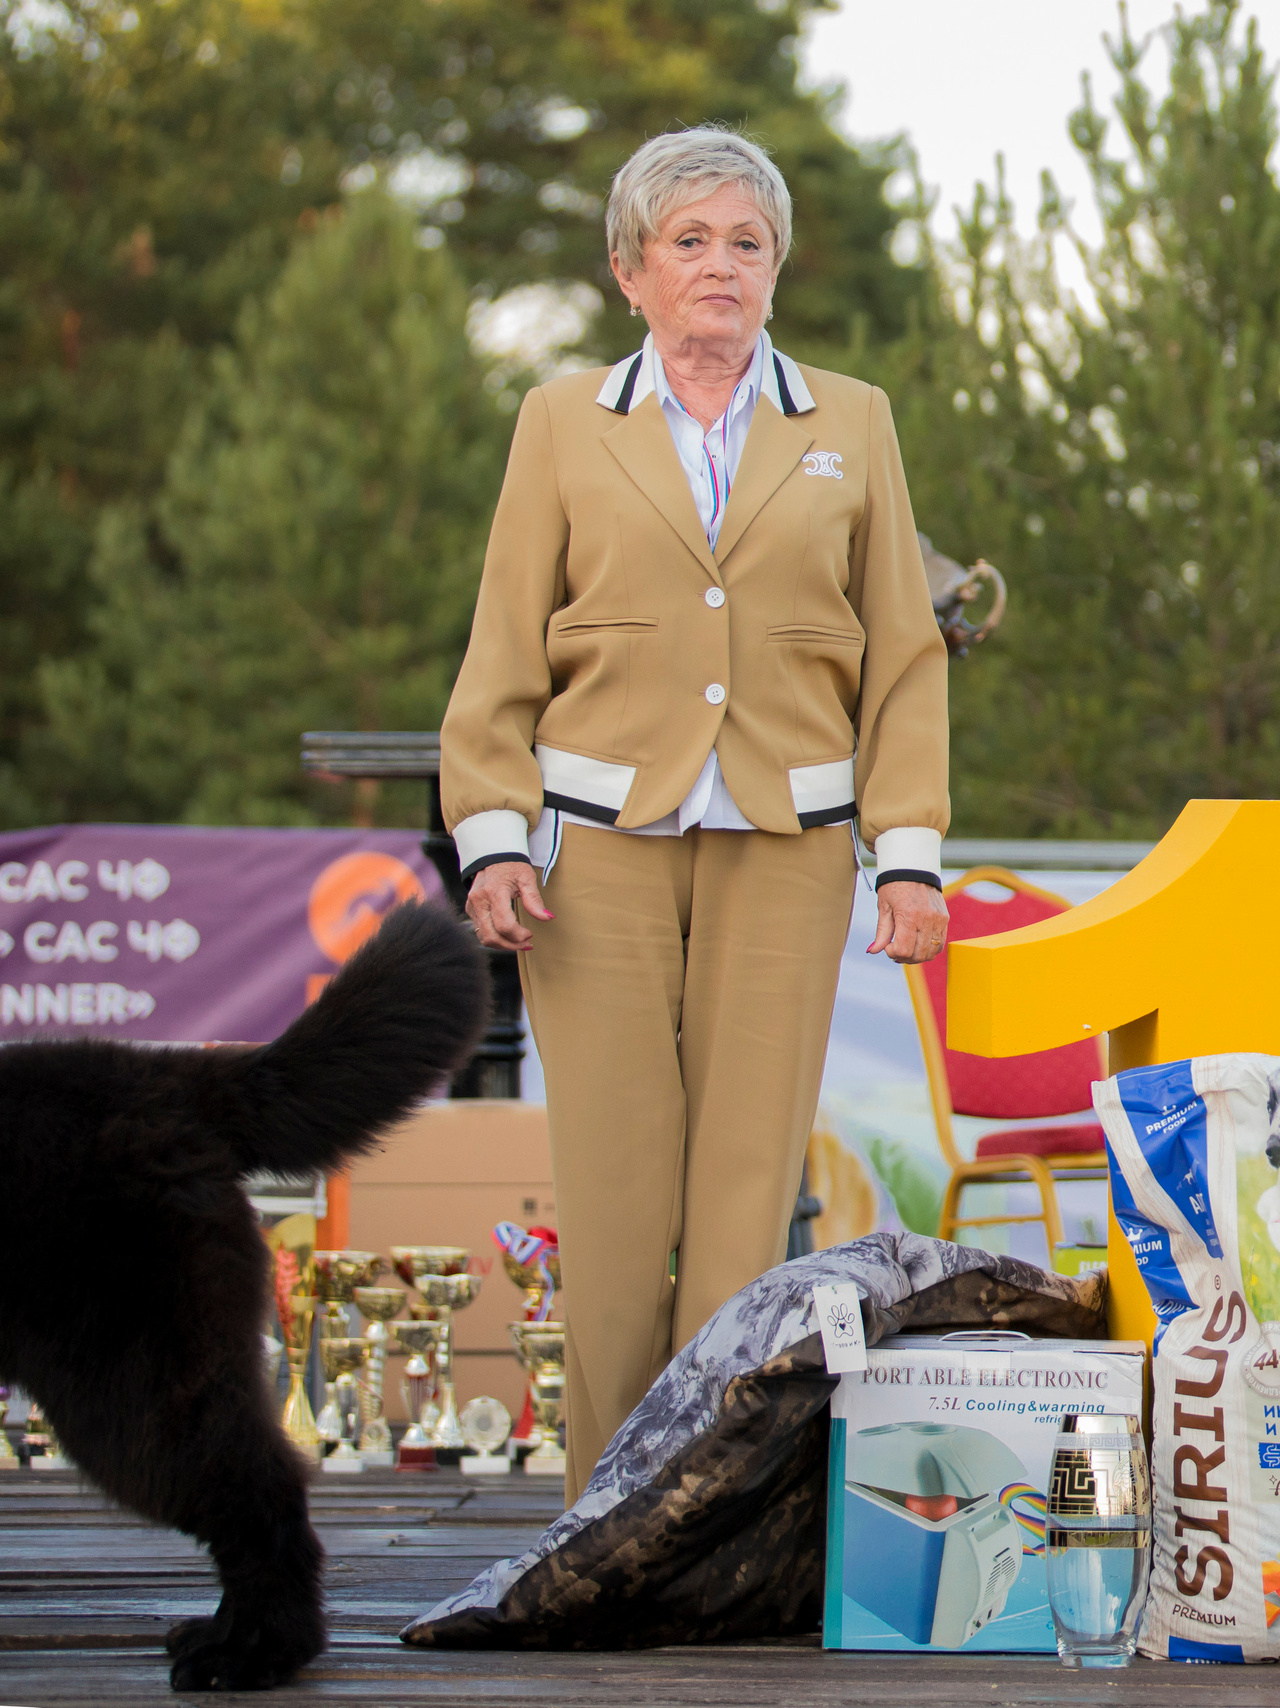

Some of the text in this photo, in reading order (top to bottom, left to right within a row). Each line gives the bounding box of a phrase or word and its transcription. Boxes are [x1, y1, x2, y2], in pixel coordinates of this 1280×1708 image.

[1145, 1100, 1198, 1135] PREMIUM
[1163, 1117, 1187, 1134] FOOD
[863, 1366, 1109, 1390] PORT ABLE ELECTRONIC
[928, 1396, 961, 1411] 7.5L
[1265, 1423, 1278, 1437] И
[1173, 1290, 1247, 1602] SIRIUS
[1172, 1604, 1236, 1626] PREMIUM
